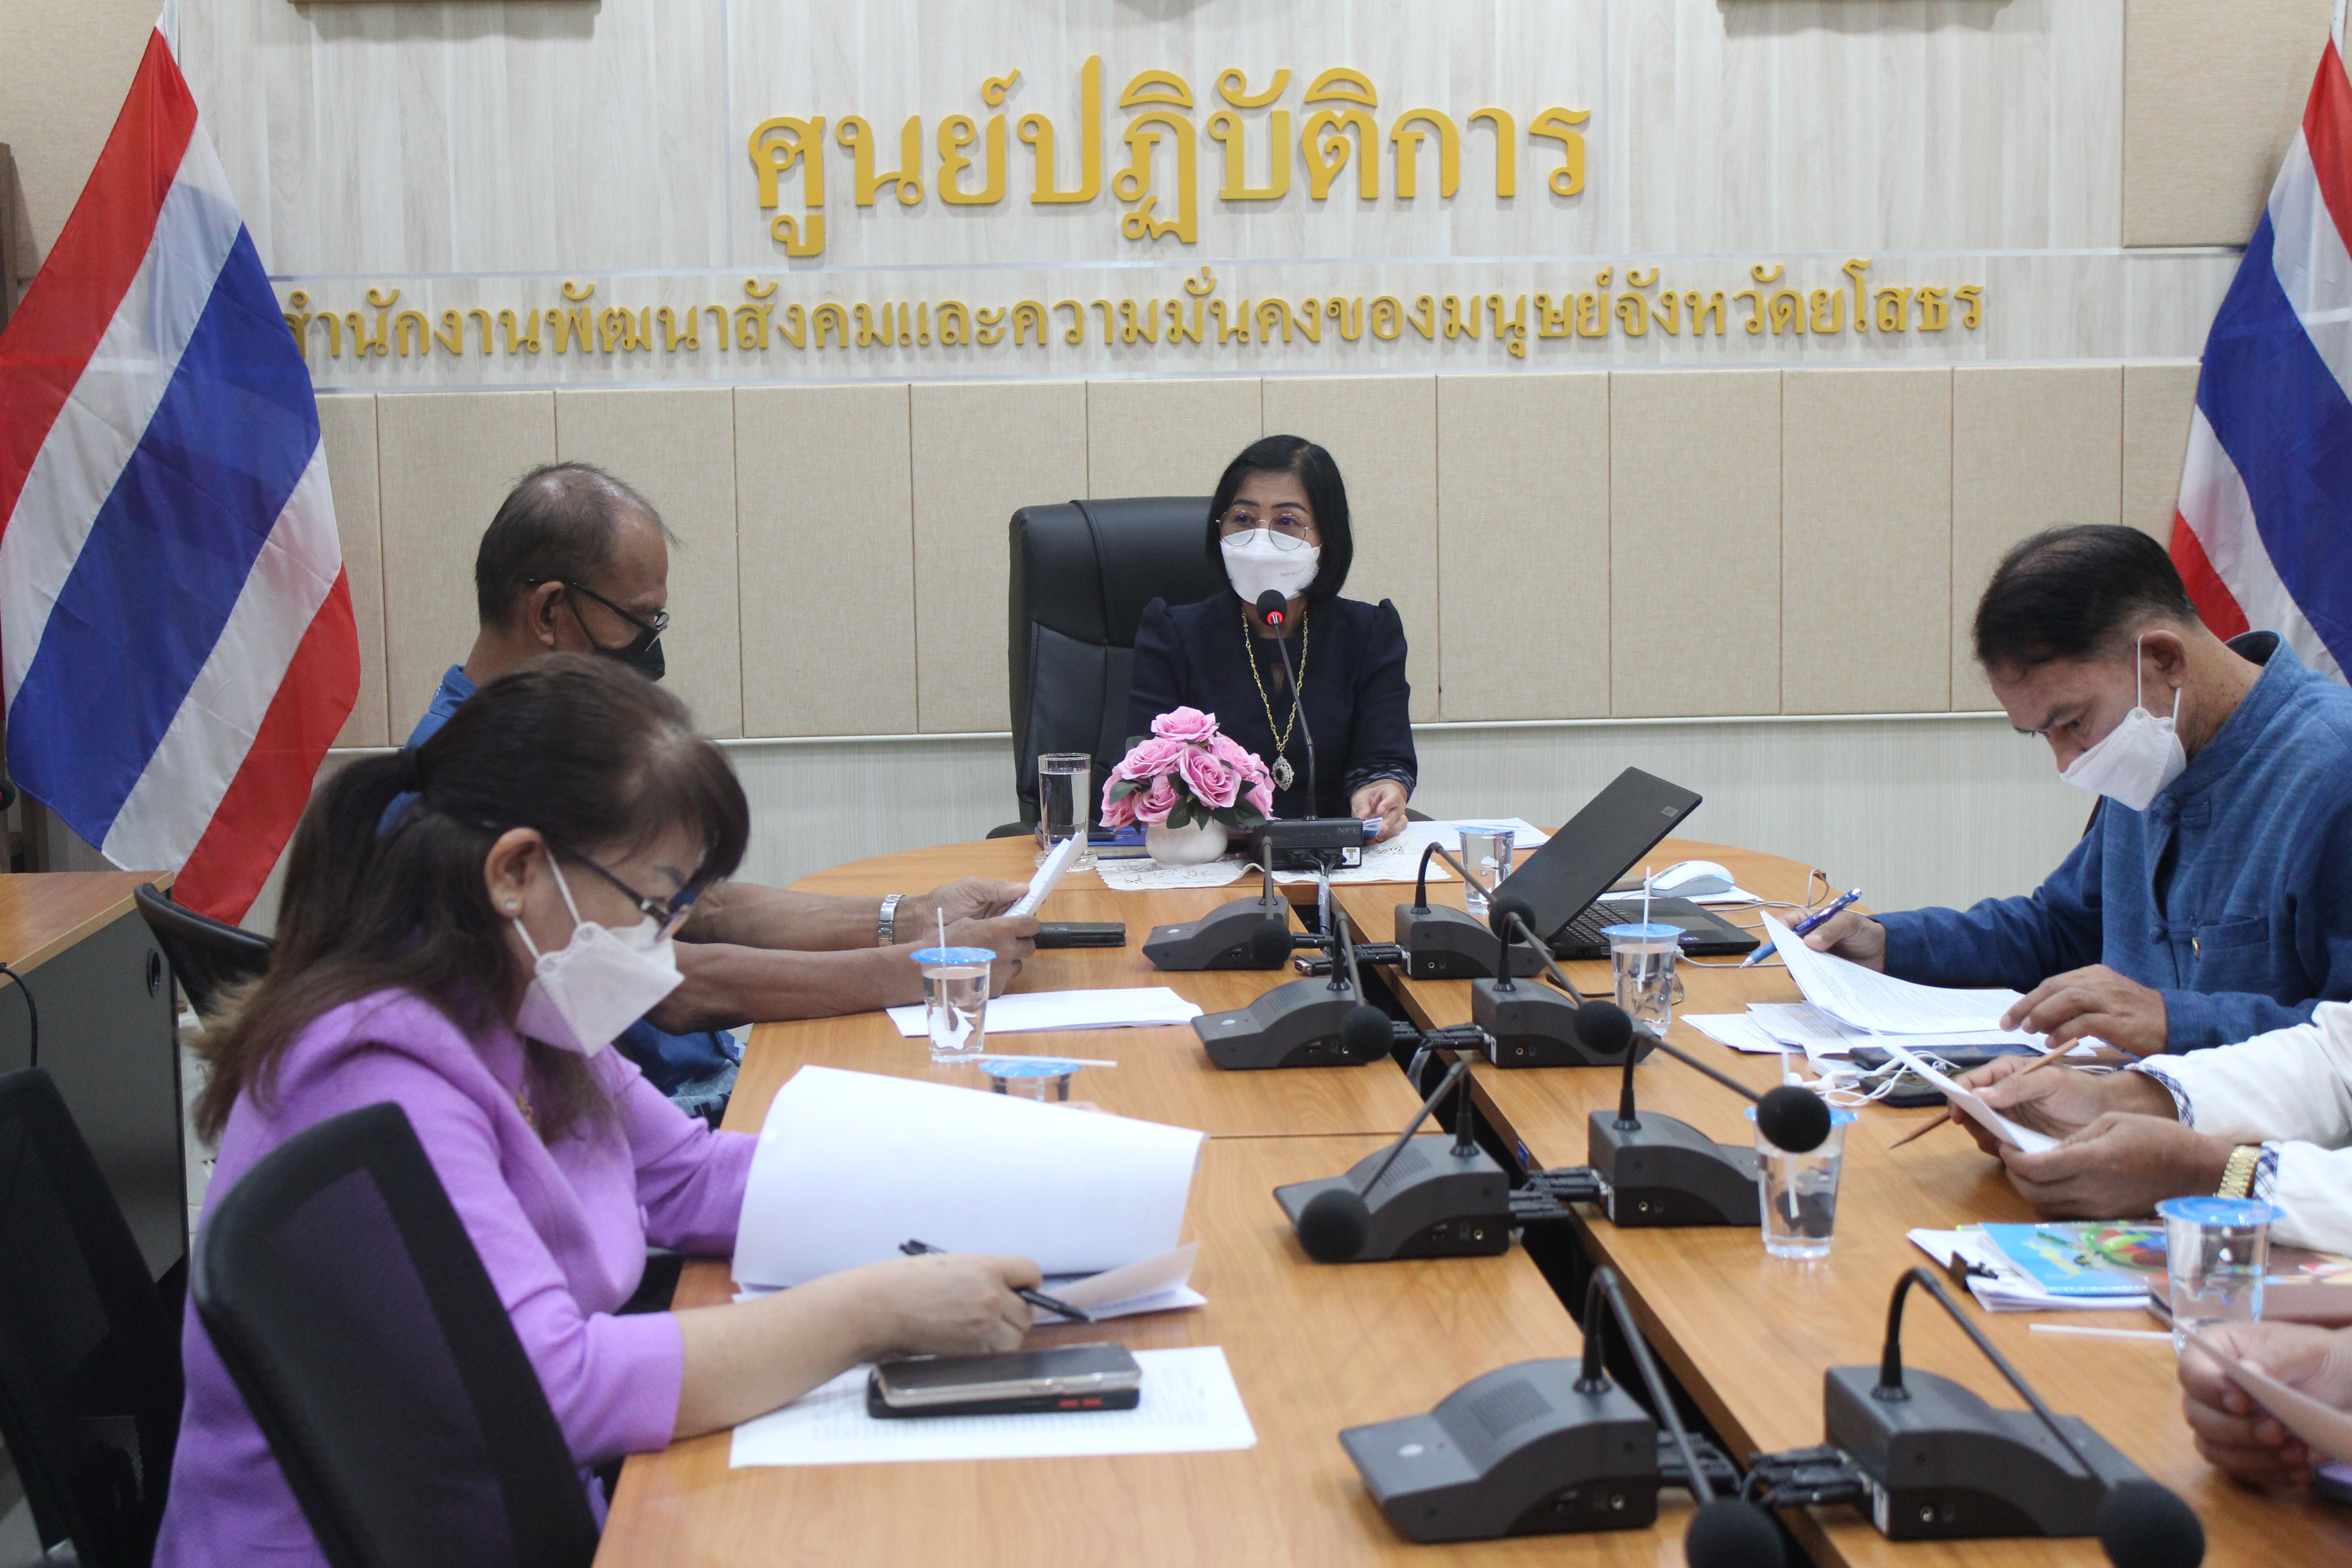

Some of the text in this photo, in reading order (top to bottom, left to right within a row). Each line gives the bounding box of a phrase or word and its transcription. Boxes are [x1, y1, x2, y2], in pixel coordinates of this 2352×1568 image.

[749, 55, 1590, 256] ศูนย์ปฏิบัติการ
